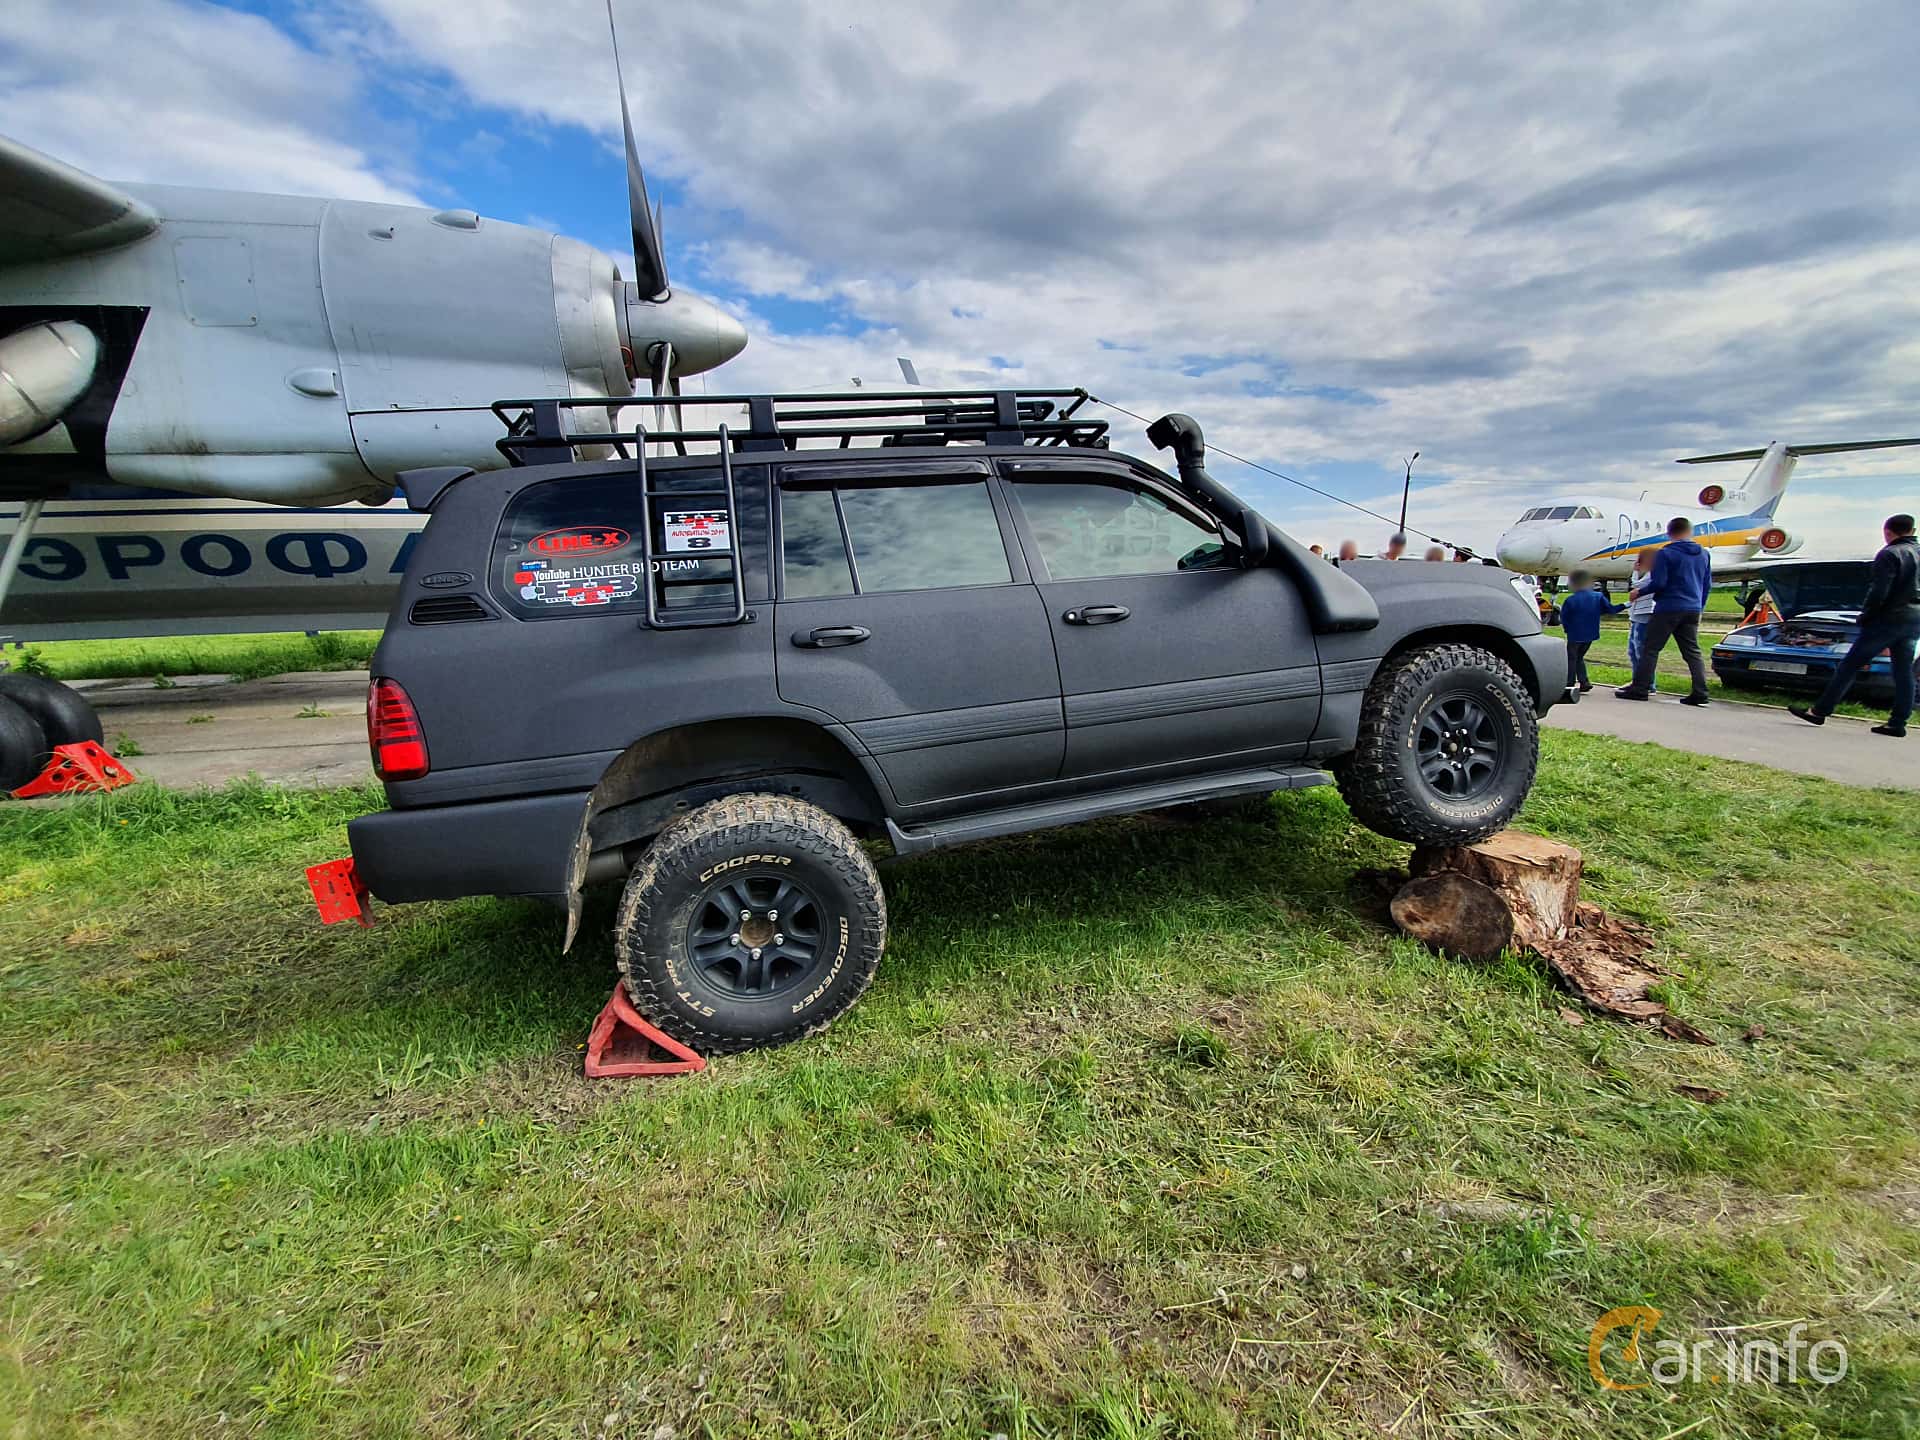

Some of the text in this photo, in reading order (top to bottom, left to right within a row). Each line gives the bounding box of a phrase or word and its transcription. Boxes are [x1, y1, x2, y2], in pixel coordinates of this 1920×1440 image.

[537, 532, 621, 551] LINE-X
[687, 537, 712, 548] 8
[533, 559, 699, 581] YouTube HUNTER BID TEAM
[1486, 682, 1523, 738] COOPER
[1429, 795, 1503, 818] DISCOVERER
[699, 854, 793, 883] COOPER
[791, 916, 849, 1015] DISCOVERER
[676, 991, 717, 1017] STT
